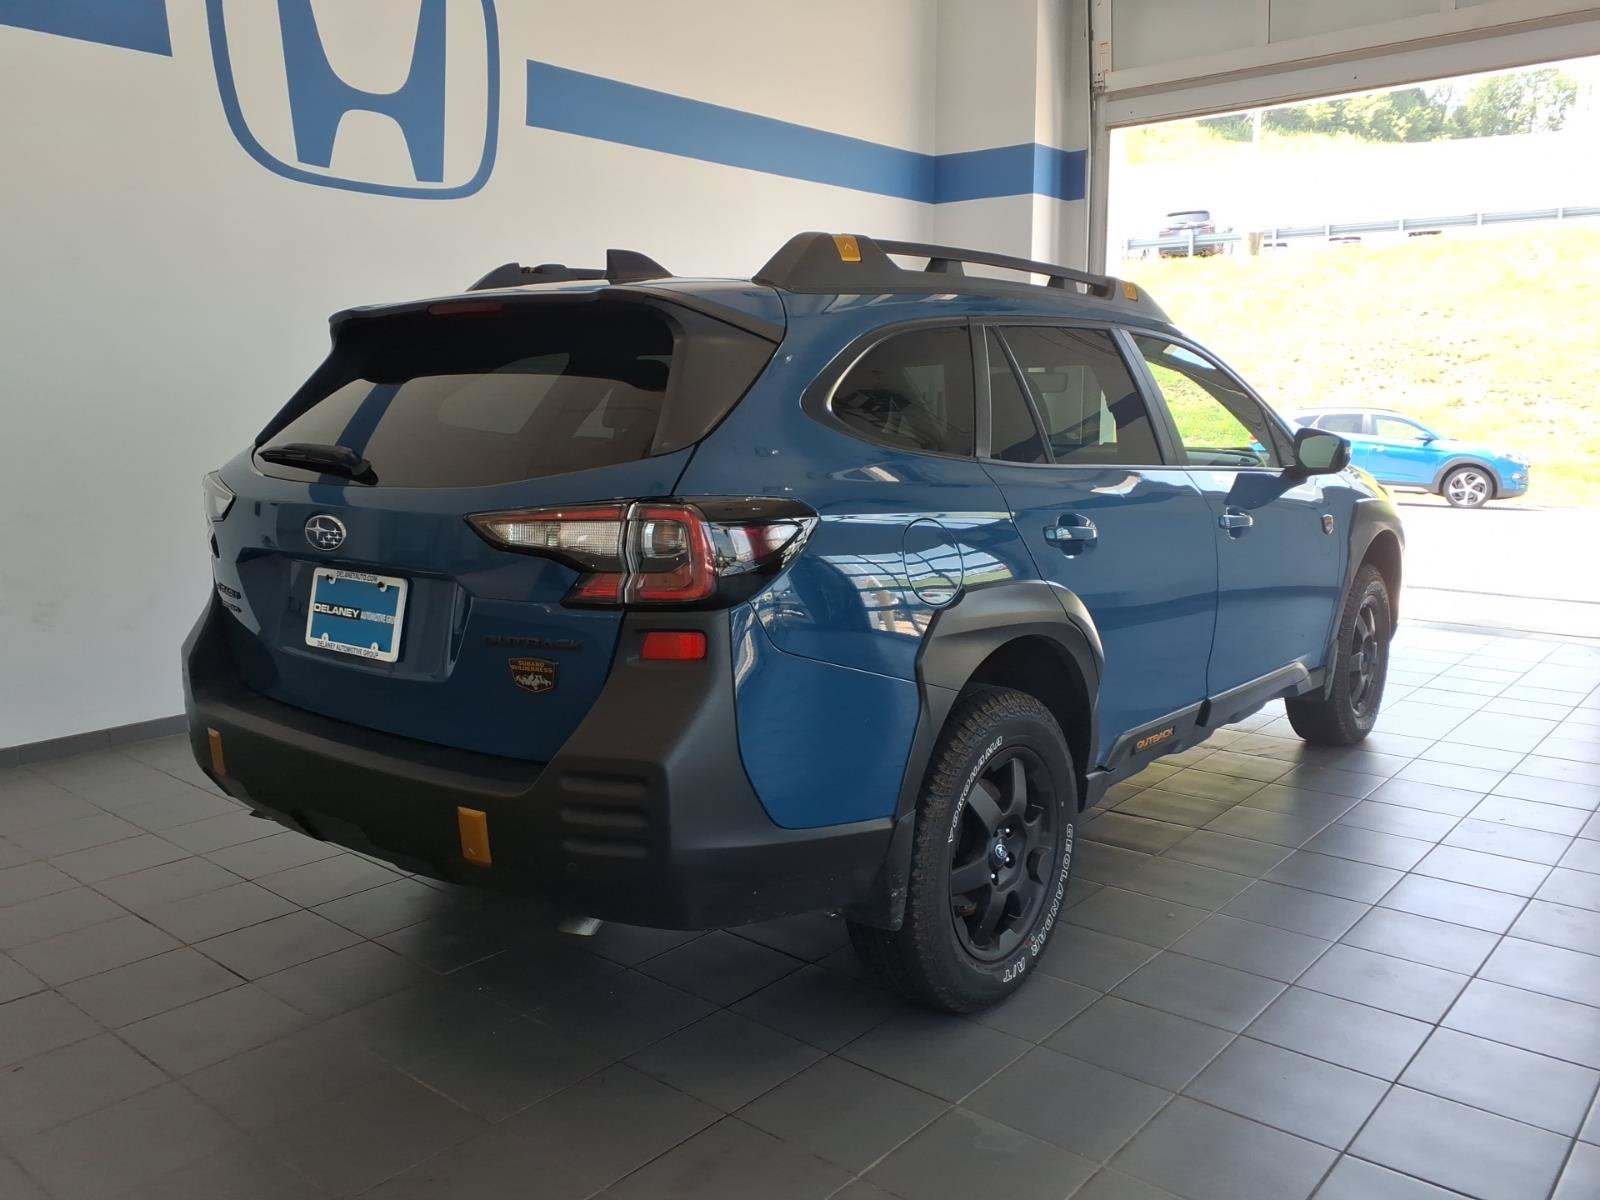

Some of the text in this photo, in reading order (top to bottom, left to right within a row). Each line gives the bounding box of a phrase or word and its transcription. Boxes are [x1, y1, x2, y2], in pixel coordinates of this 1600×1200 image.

[313, 603, 360, 618] DELANEY
[1136, 727, 1174, 749] OUTBACK
[947, 735, 1003, 843] YOKOHAMA
[1002, 823, 1073, 983] GEOLANDAR A/T
